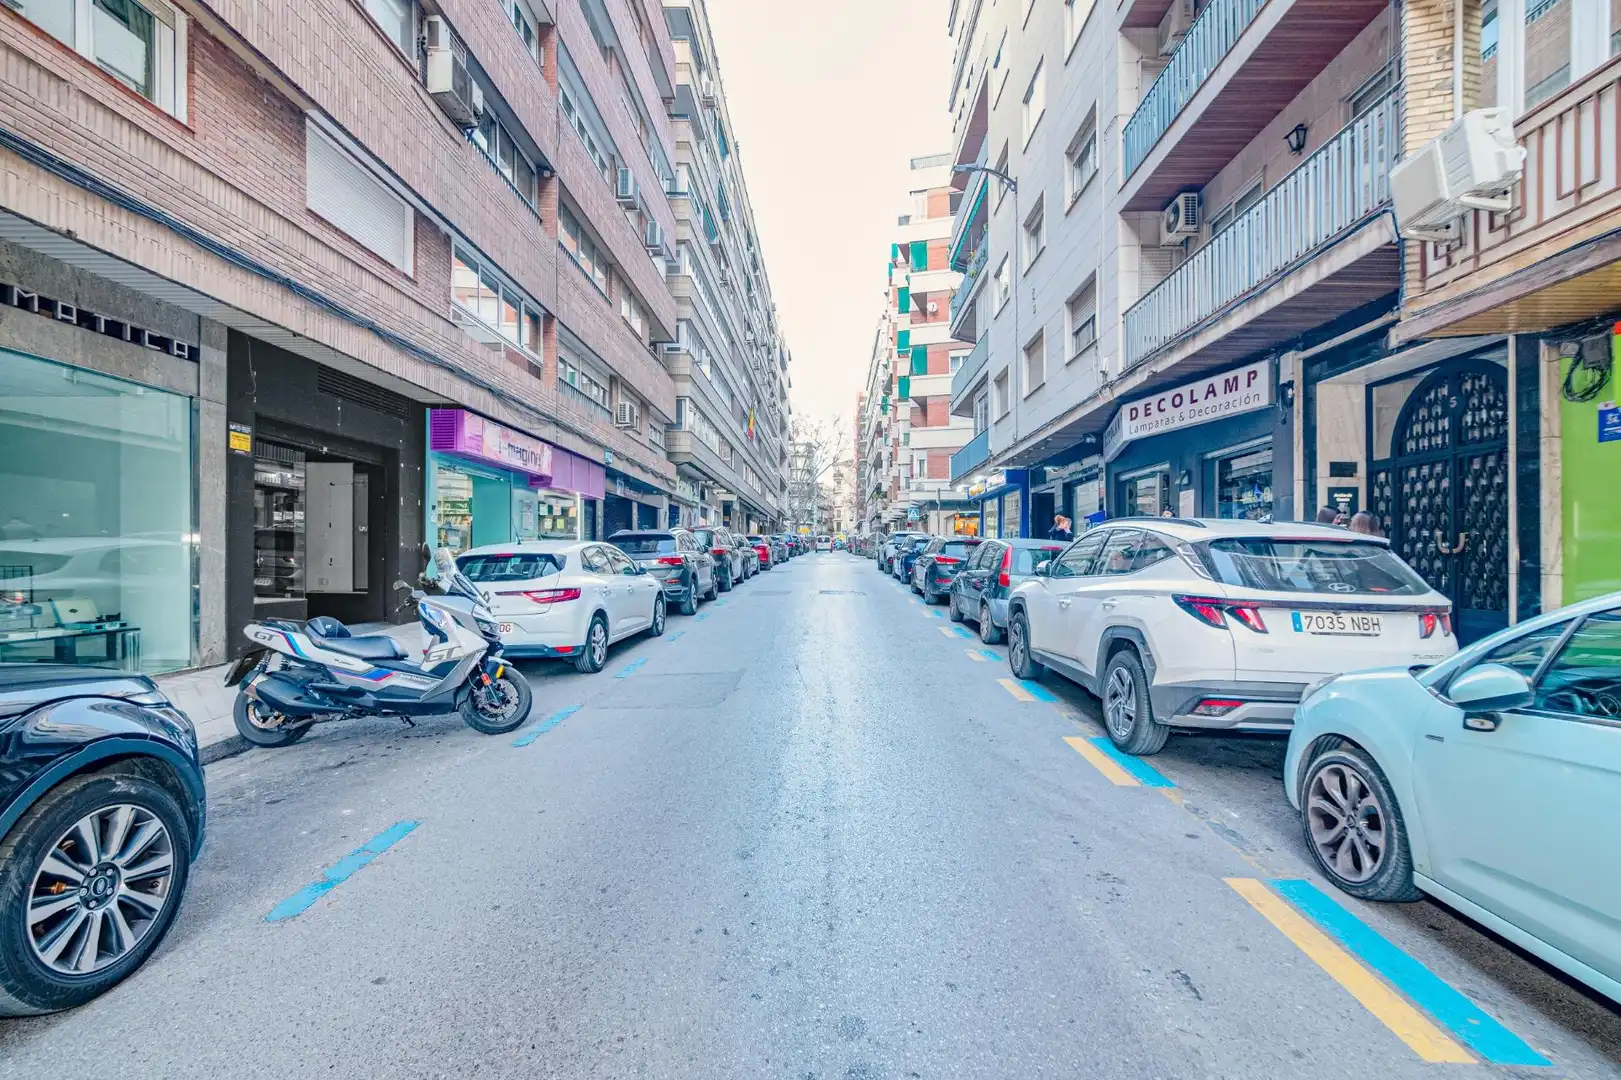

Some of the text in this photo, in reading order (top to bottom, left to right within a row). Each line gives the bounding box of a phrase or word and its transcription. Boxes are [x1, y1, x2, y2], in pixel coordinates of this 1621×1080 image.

[13, 286, 188, 359] MATICA
[1129, 369, 1258, 421] DECOLAMP
[1450, 396, 1458, 408] 5
[1178, 411, 1186, 422] &
[1189, 393, 1260, 420] Decoración
[1304, 615, 1381, 632] 7035 NBH
[253, 631, 276, 642] GT
[425, 645, 462, 663] GT
